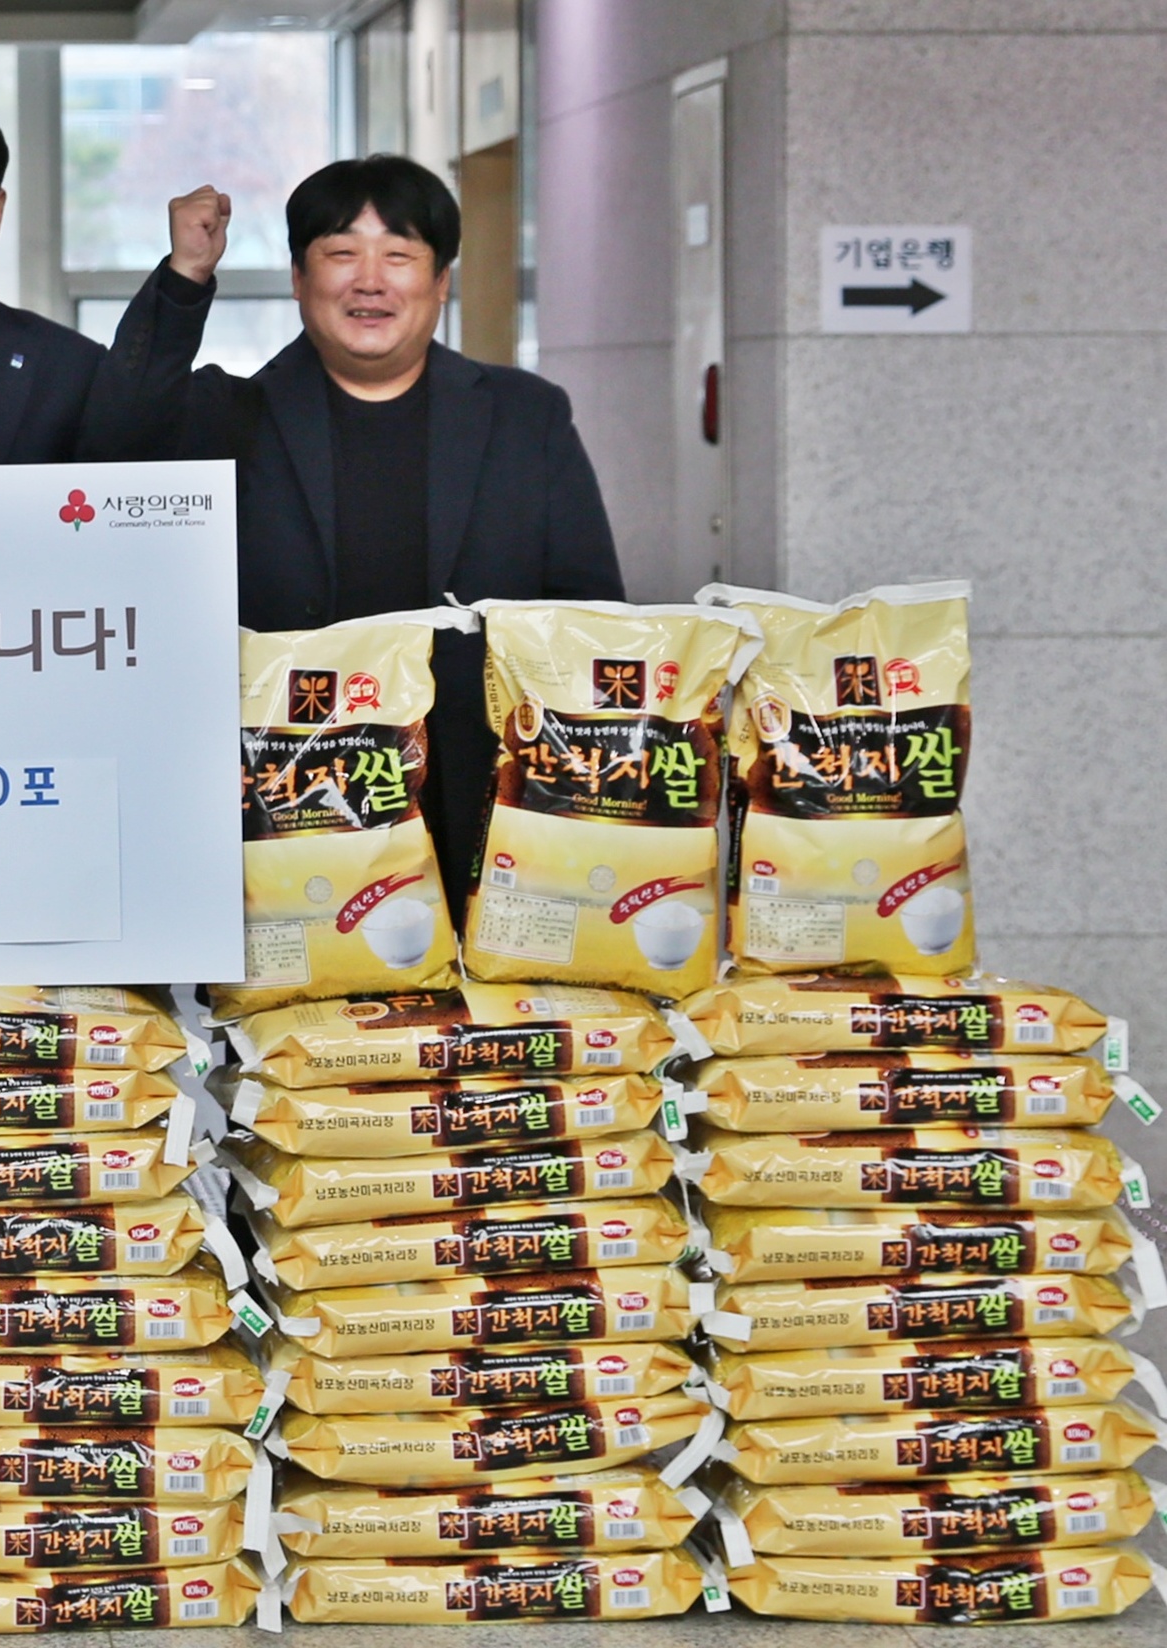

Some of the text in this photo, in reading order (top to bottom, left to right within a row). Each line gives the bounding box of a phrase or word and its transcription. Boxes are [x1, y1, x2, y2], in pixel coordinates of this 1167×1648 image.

[835, 237, 955, 271] 기업은행
[101, 493, 213, 519] 사랑의열매
[109, 518, 206, 530] Community Chest of Korea
[517, 742, 706, 809] 간척지쌀
[766, 727, 963, 799] 간척지쌀
[272, 809, 299, 821] Good
[572, 793, 648, 811] Good Morning!
[453, 1032, 561, 1068] 간척지쌀
[89, 1085, 114, 1097] 10kg
[316, 1181, 416, 1200] 남포농산미곡처리장
[468, 1158, 573, 1193] 간척지쌀
[900, 1160, 1007, 1196] 간척지쌀
[0, 1226, 104, 1261] 간척지쌀
[471, 1224, 578, 1260] 간척지쌀
[916, 1235, 1024, 1269] 간척지쌀
[14, 1299, 123, 1338] 간척지쌀
[335, 1318, 435, 1335] 남포농산미곡처리장
[487, 1299, 593, 1332] 간척지쌀
[903, 1294, 1011, 1327] 간척지쌀
[314, 1377, 414, 1391] 남포농산미곡처리장
[467, 1359, 574, 1395] 간척지쌀
[917, 1369, 1024, 1398] 간척지쌀
[42, 1379, 144, 1415] 간척지쌀
[170, 1456, 195, 1468] 10kg
[933, 1429, 1038, 1464] 간척지쌀
[34, 1453, 141, 1488] 간척지쌀
[173, 1520, 198, 1531] 10kg
[473, 1502, 578, 1539] 간척지쌀
[39, 1521, 146, 1556] 간척지쌀
[51, 1590, 158, 1622] 간척지쌀
[184, 1584, 208, 1597] 10kg
[481, 1574, 586, 1608] 간척지쌀
[931, 1575, 1035, 1609] 간척지쌀
